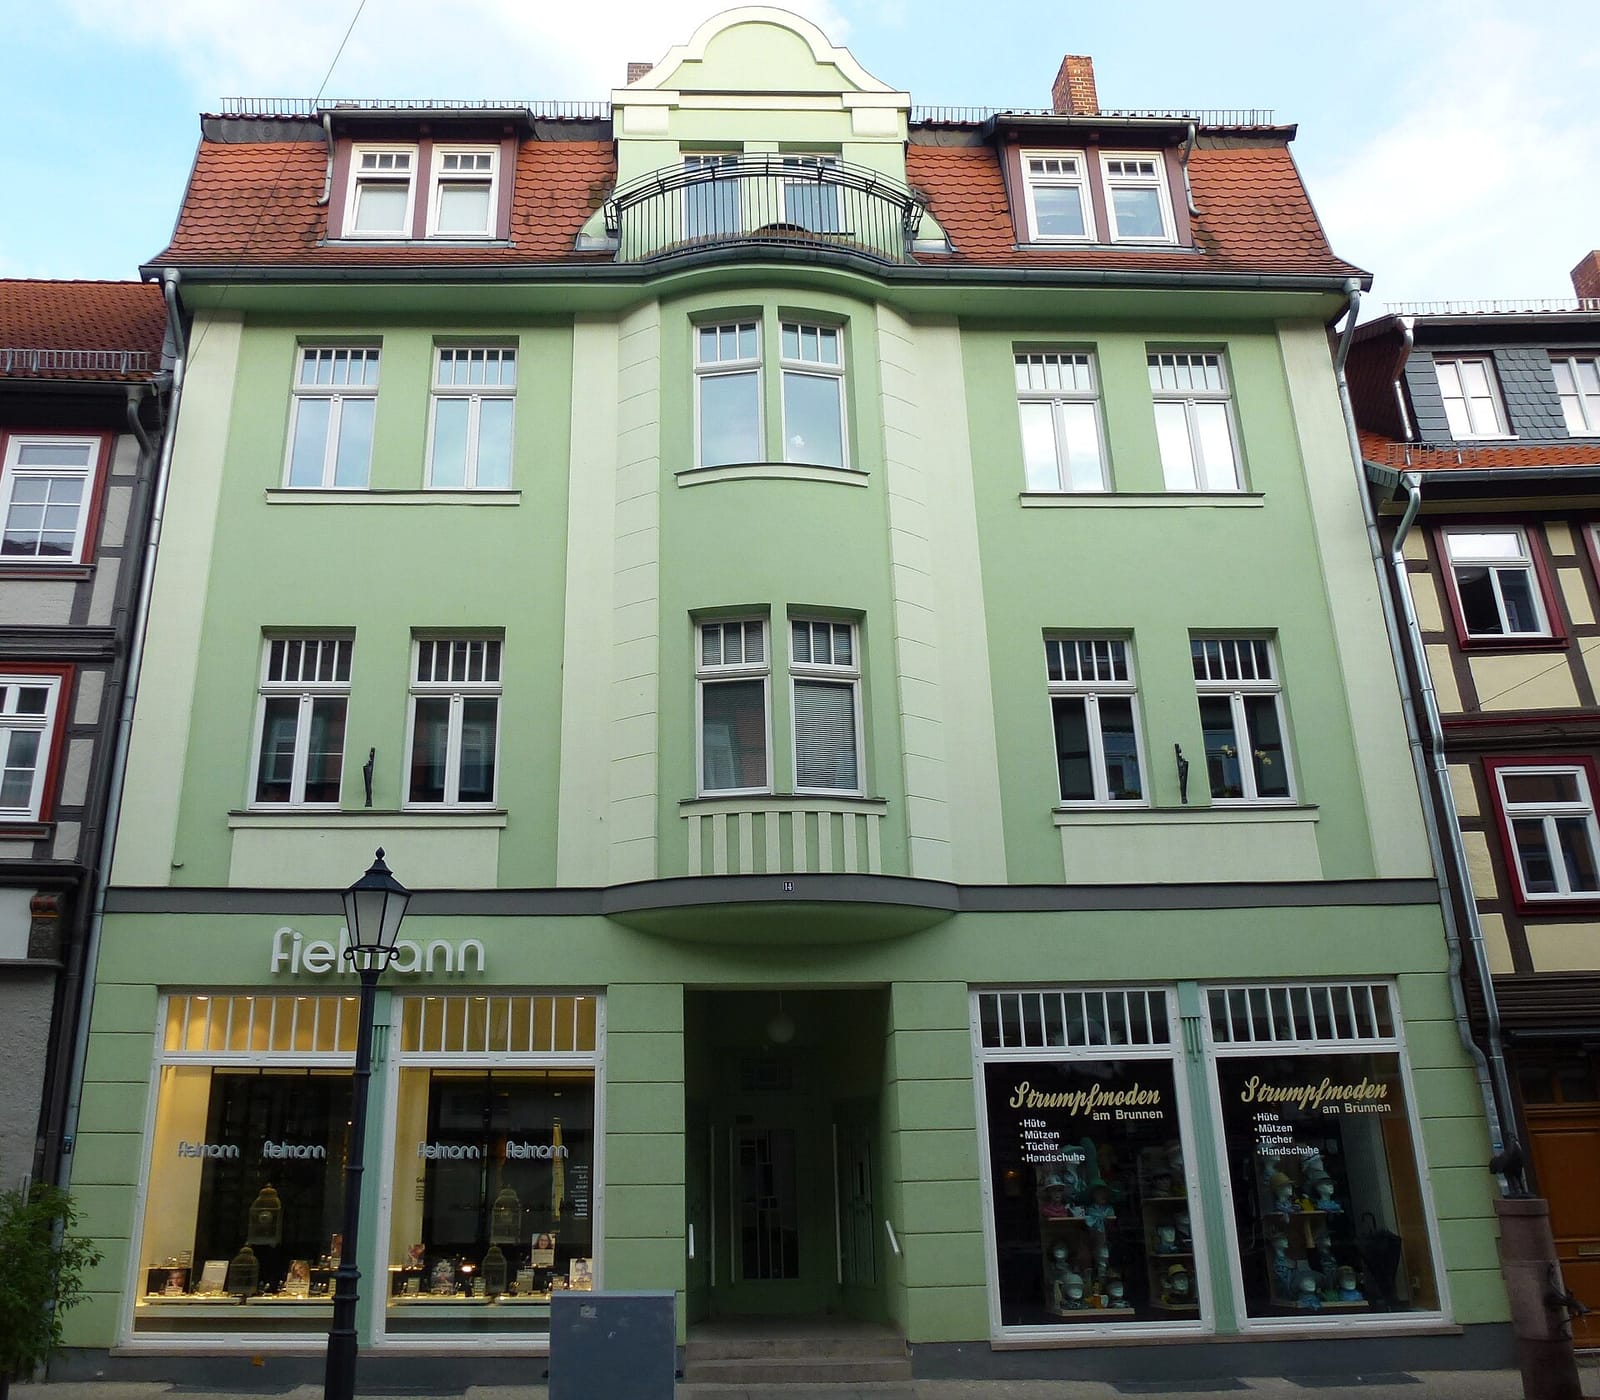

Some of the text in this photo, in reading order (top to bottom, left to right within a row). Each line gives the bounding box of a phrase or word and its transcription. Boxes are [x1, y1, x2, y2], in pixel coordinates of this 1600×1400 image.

[784, 882, 793, 891] 14
[1241, 1075, 1388, 1111] Strumpfmoden
[1009, 1081, 1161, 1117] Strumpfmoden
[1322, 1102, 1392, 1115] am Brunnen
[1092, 1108, 1164, 1121] am Brunnen
[1256, 1111, 1280, 1122] Hüte
[1023, 1118, 1047, 1128] Hüte
[1258, 1123, 1294, 1134] Mützen
[1024, 1129, 1060, 1140] Mützen
[1260, 1134, 1293, 1145] Tücher
[263, 1140, 326, 1159] fielmann
[416, 1140, 480, 1160] fielmann
[505, 1140, 569, 1160] fielmann
[1026, 1141, 1060, 1152] Tücher
[1261, 1145, 1320, 1157] Handschuhe
[1026, 1152, 1086, 1163] Handschuhe
